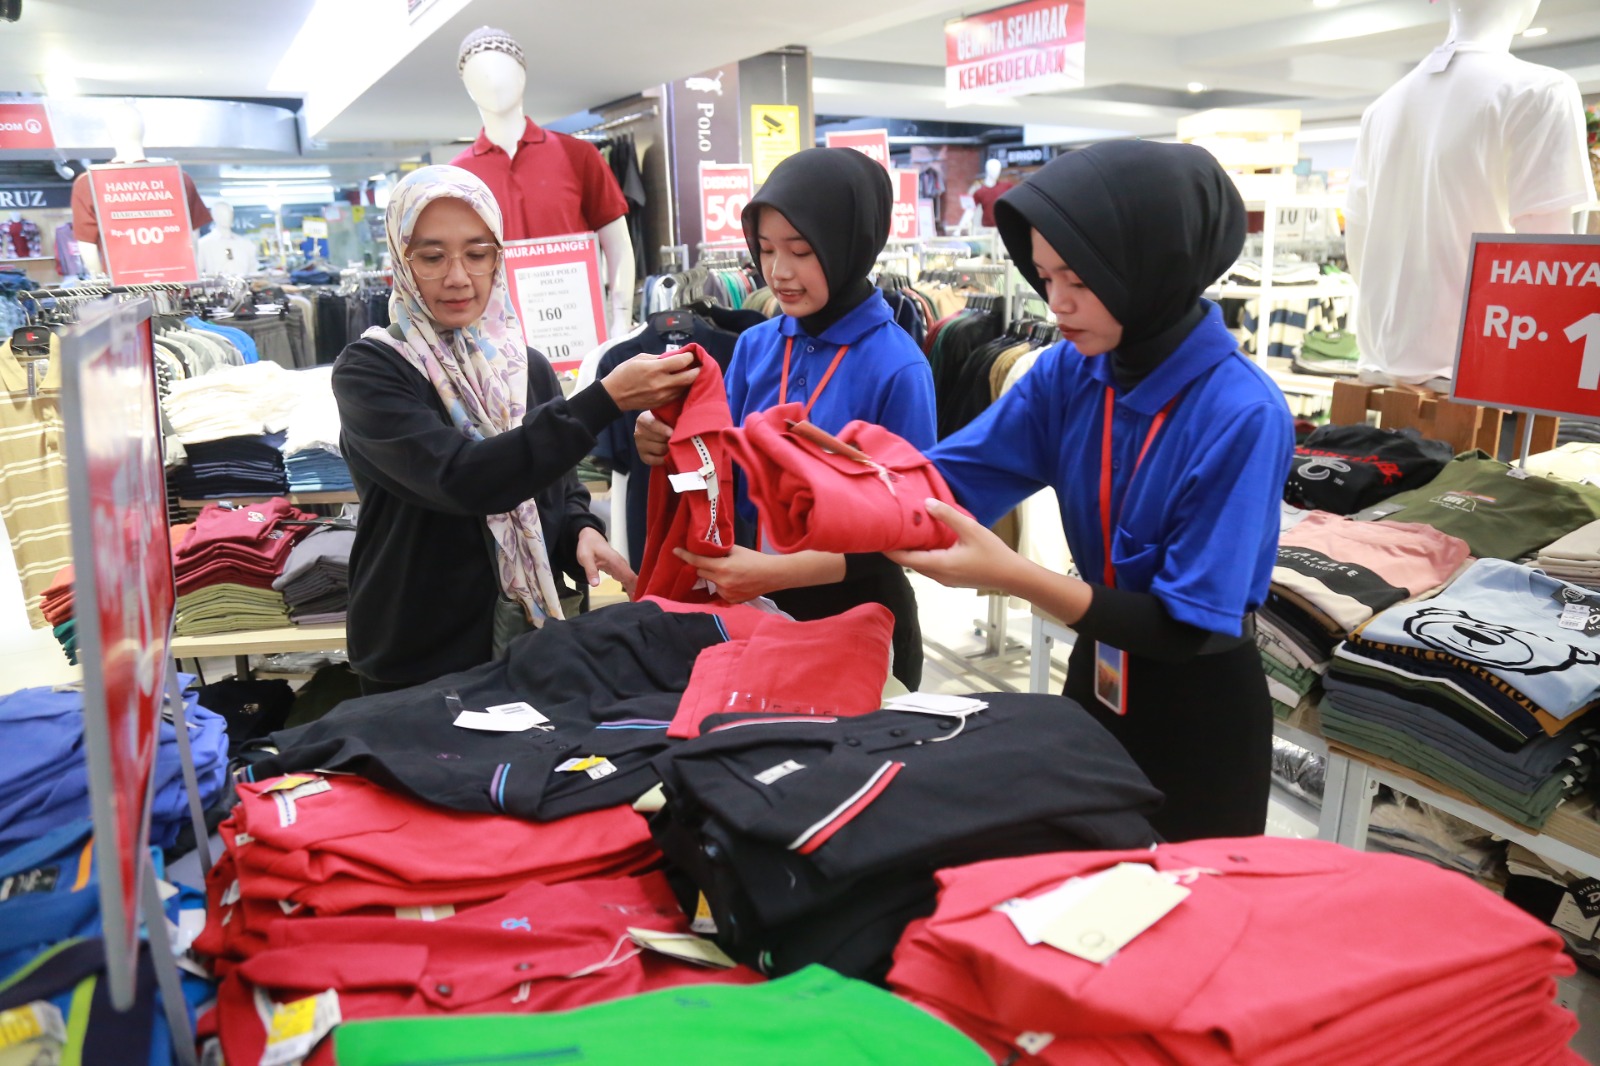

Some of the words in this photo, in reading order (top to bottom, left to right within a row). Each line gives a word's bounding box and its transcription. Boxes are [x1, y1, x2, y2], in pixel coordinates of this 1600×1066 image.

[1008, 4, 1068, 49] SEMARAK
[959, 47, 1065, 90] KEMERDEKAAN
[697, 102, 715, 152] POLO
[105, 181, 149, 193] HANYA
[150, 180, 164, 190] DI
[703, 175, 748, 190] DISKON
[0, 190, 47, 207] RUZ
[104, 190, 173, 203] RAMAYANA
[504, 245, 545, 259] MURAH
[547, 240, 590, 254] BANGET
[1489, 259, 1600, 288] HANYA
[538, 307, 562, 322] 160
[1482, 304, 1549, 350] Rp.
[546, 344, 570, 359] 110
